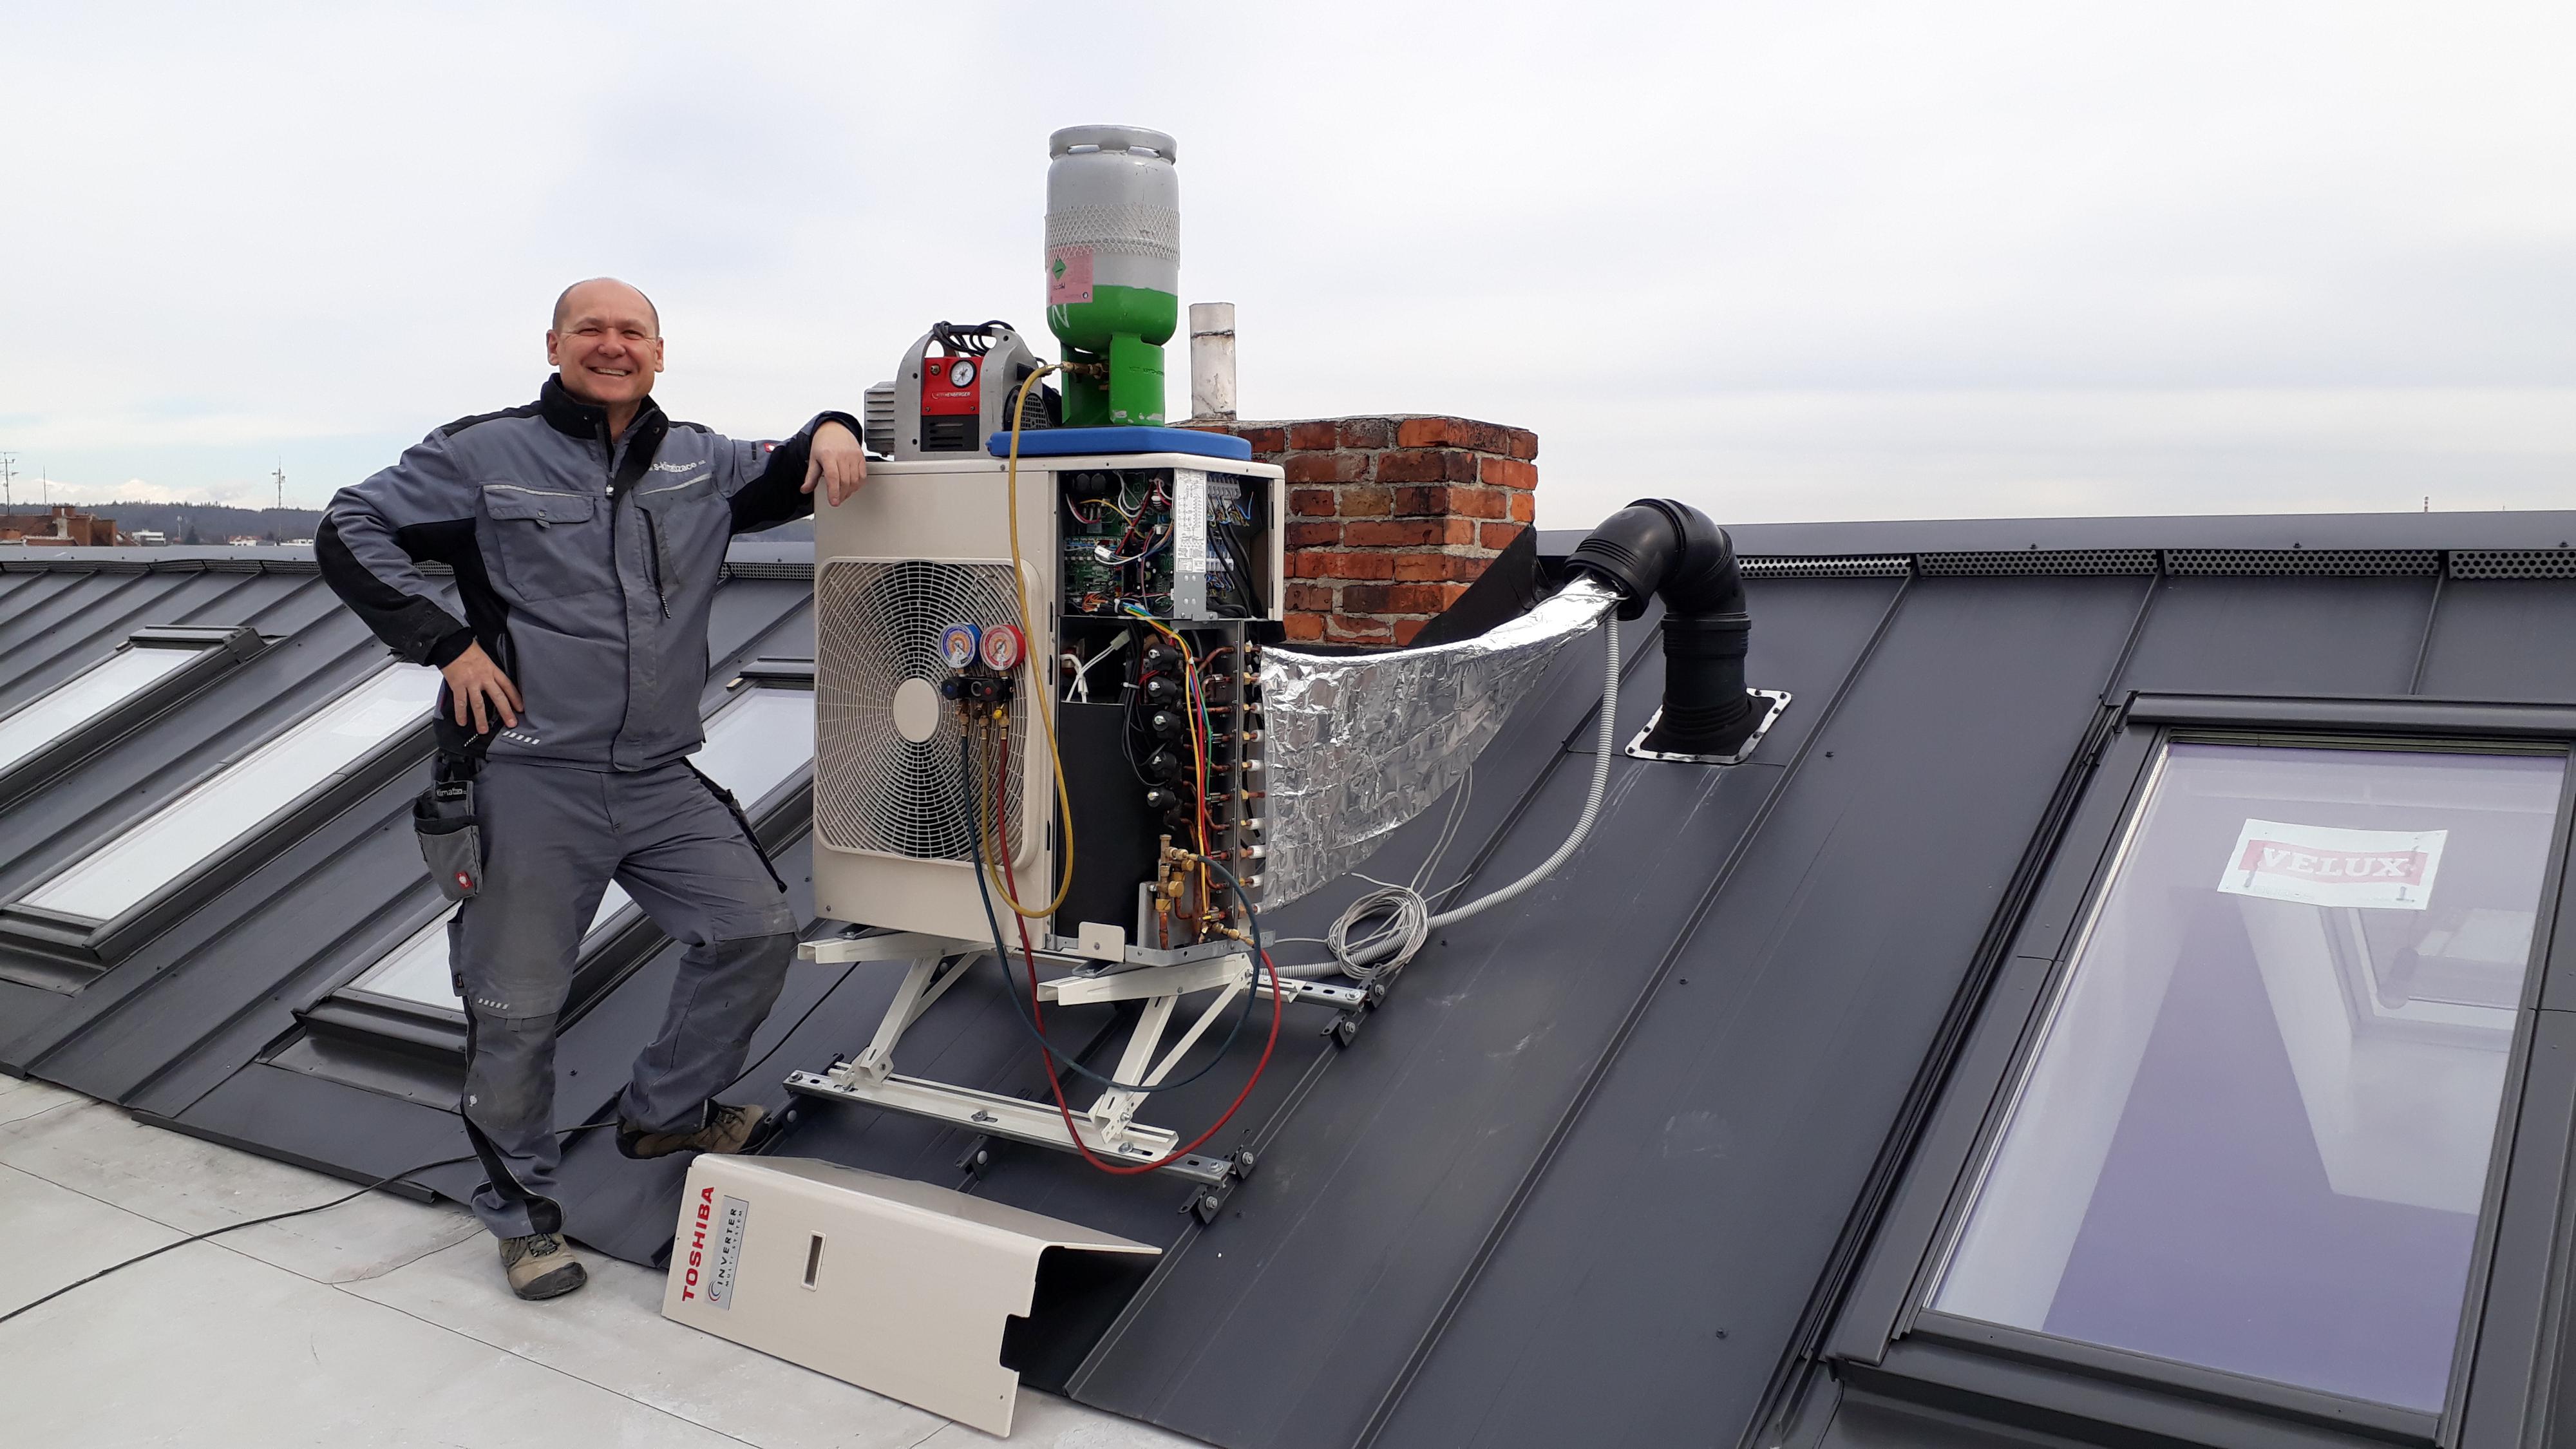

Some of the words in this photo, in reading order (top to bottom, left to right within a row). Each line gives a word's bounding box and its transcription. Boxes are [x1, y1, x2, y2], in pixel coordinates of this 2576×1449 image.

[2262, 847, 2410, 877] VELUX
[682, 1186, 715, 1302] TOSHIBA
[717, 1208, 737, 1285] INVERTER
[725, 1256, 734, 1287] MULTI
[732, 1211, 743, 1249] SYSTEM
